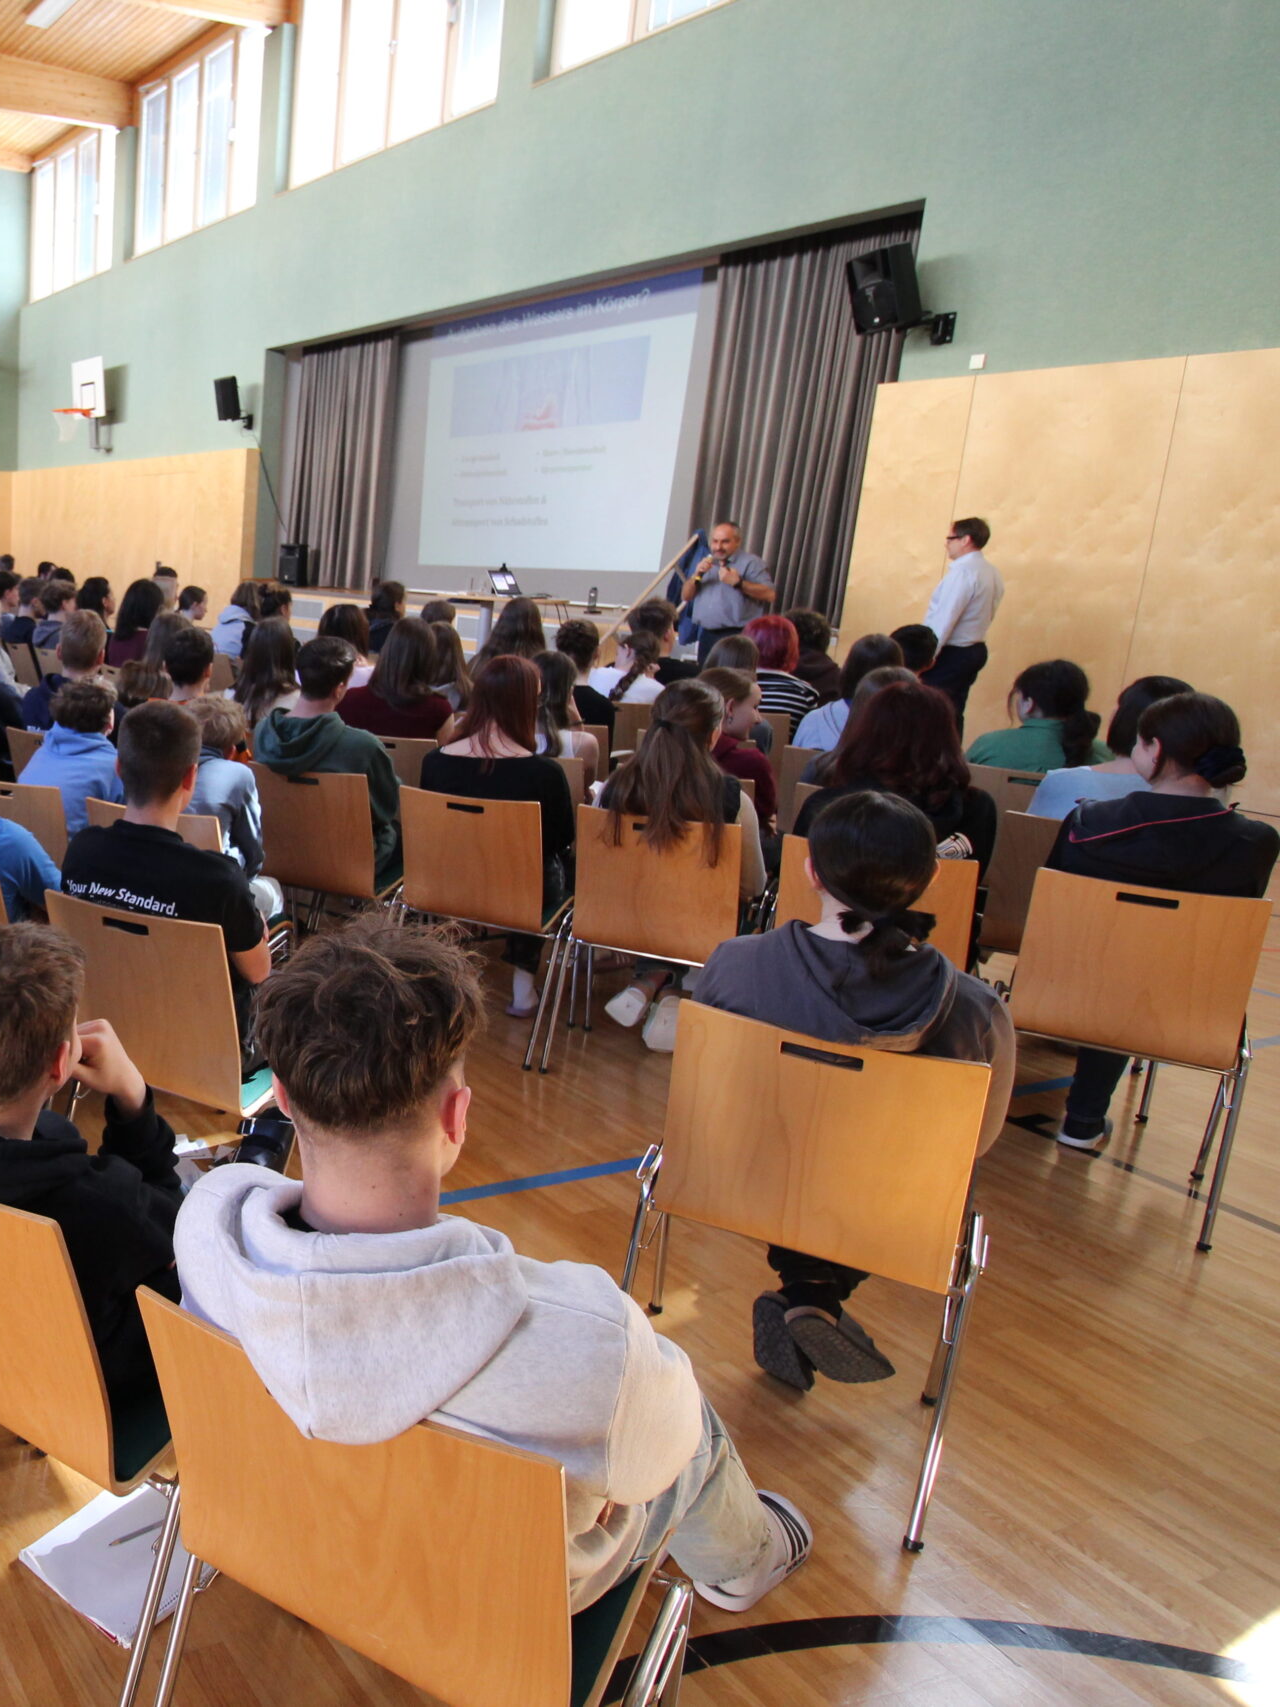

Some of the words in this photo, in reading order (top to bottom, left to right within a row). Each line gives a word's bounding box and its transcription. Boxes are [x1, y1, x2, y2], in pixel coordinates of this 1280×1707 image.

[521, 307, 573, 329] Wassers
[576, 301, 593, 317] im
[595, 287, 651, 315] Körper?
[66, 879, 86, 893] Your
[89, 881, 116, 897] New
[115, 888, 179, 917] Standard.
